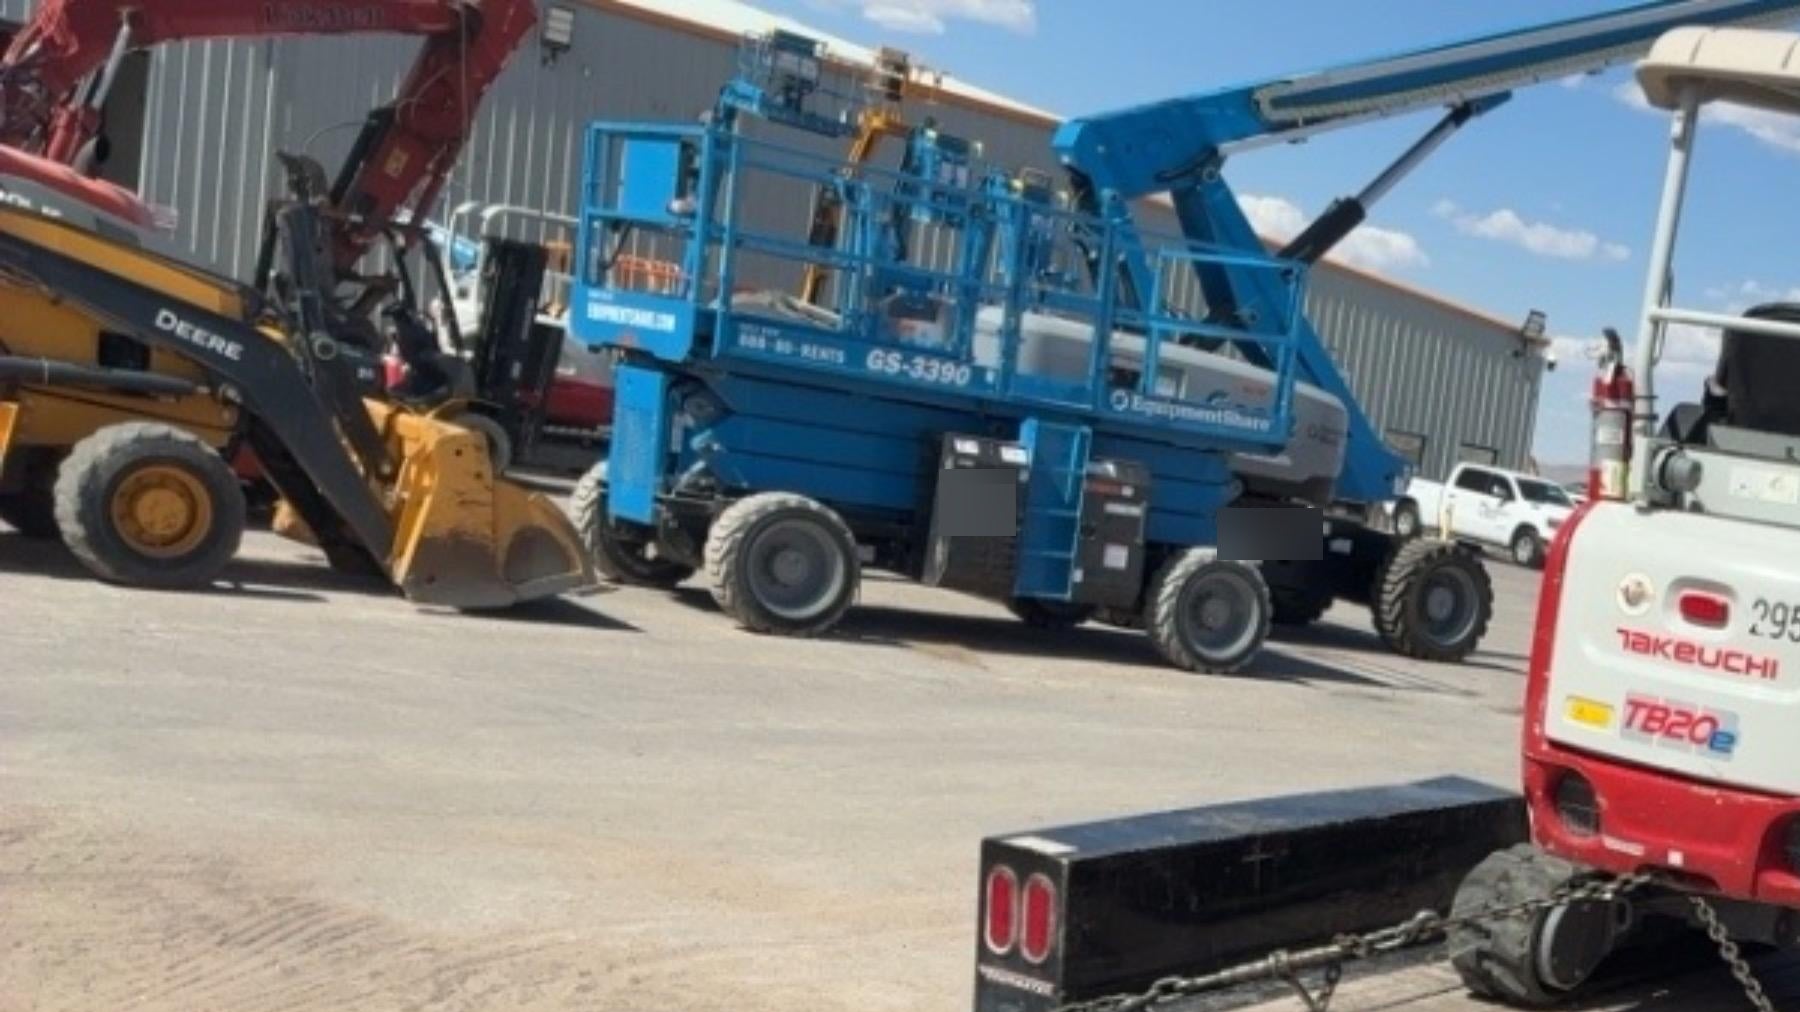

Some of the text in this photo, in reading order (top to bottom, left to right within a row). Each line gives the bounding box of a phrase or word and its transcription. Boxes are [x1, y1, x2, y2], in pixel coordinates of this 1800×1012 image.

[155, 308, 244, 361] DEERE
[866, 349, 971, 386] GS-3390
[1131, 394, 1271, 431] EquipmentShare
